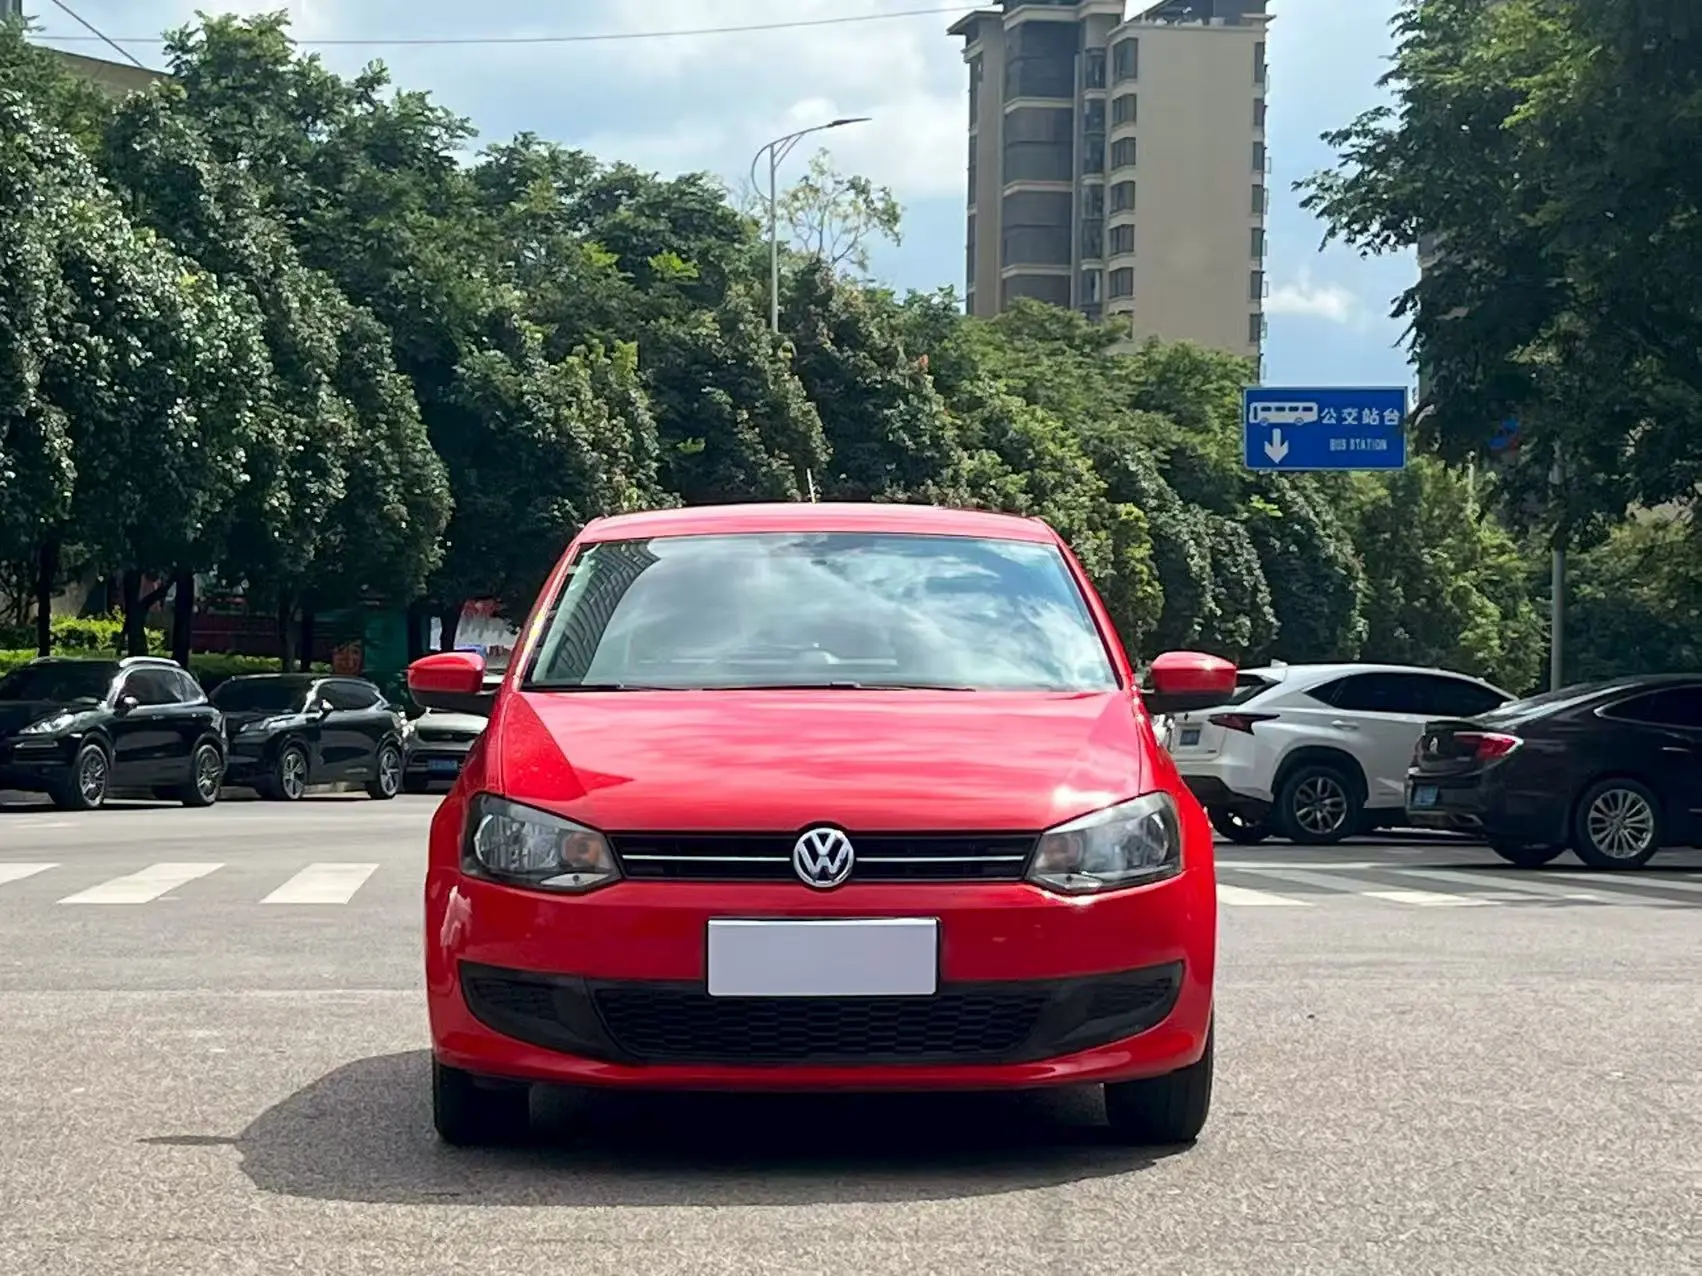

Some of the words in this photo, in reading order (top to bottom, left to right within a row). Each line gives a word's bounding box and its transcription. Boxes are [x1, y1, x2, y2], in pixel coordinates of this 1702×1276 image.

[1320, 407, 1400, 425] 公交站台
[1329, 438, 1347, 451] BUS
[1349, 438, 1388, 450] STATION
